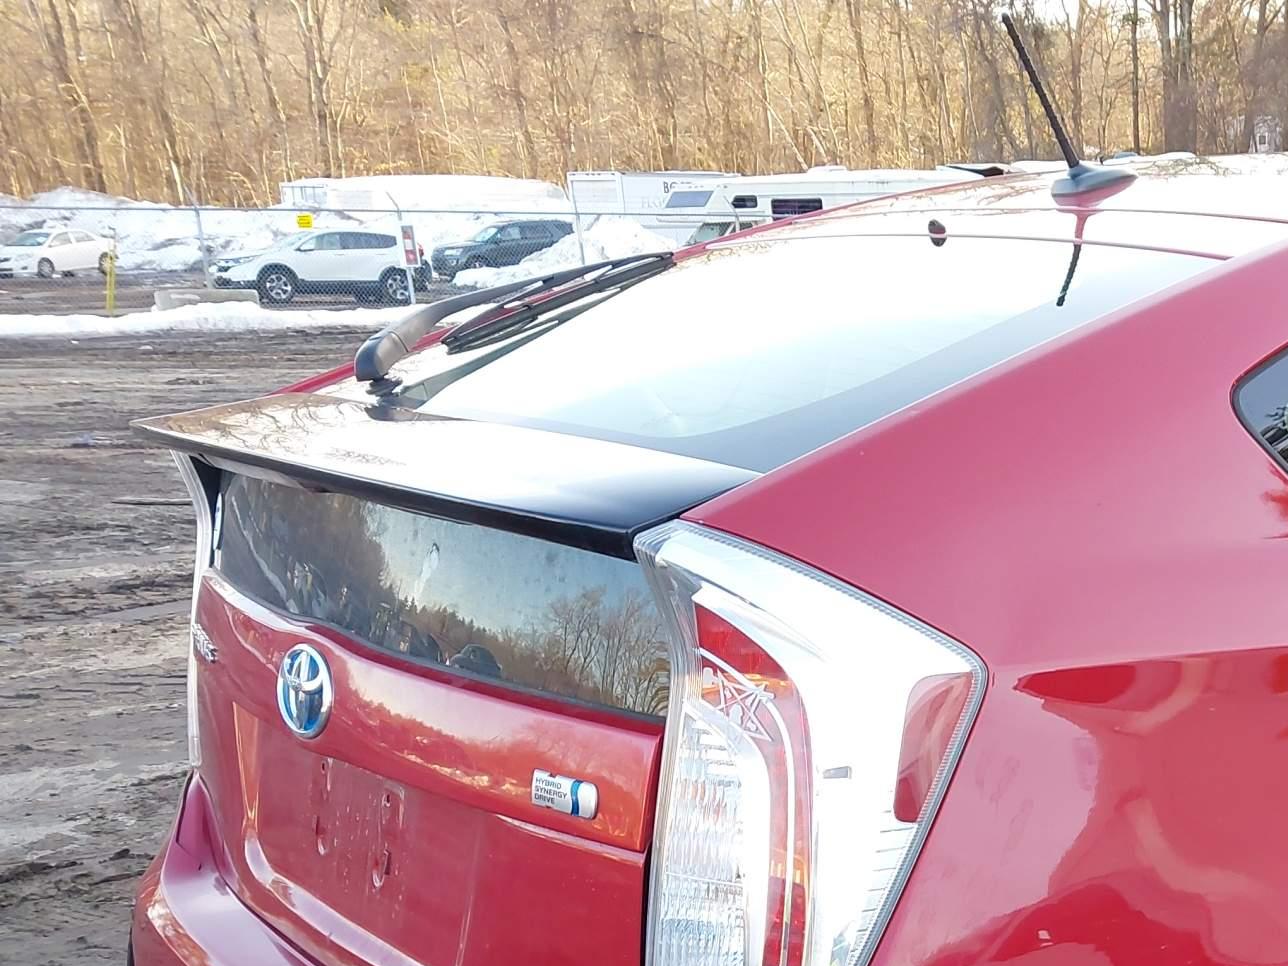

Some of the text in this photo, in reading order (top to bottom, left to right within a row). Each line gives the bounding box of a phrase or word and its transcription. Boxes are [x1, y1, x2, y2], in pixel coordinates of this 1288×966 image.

[535, 777, 562, 790] HYBRID
[534, 785, 567, 800] SYNERGY
[534, 793, 555, 805] DRIVE
